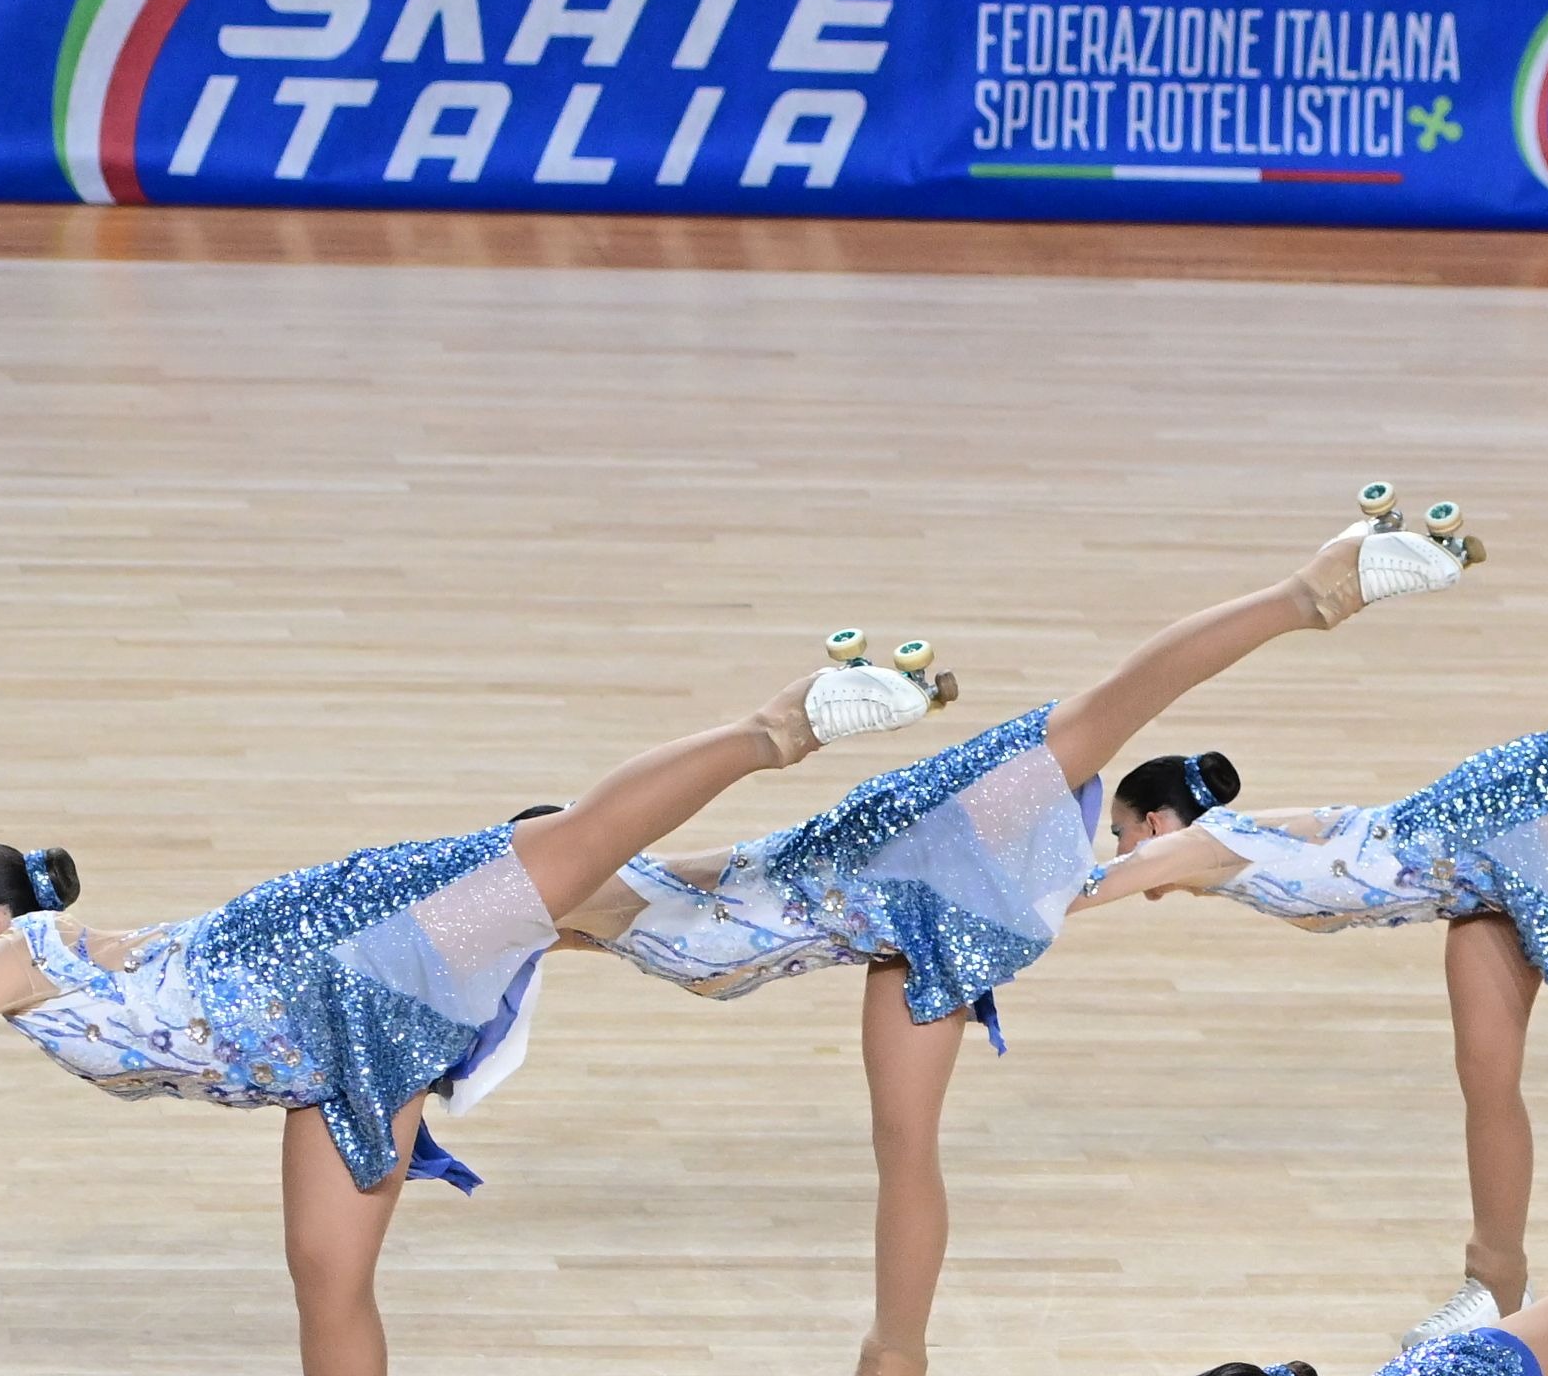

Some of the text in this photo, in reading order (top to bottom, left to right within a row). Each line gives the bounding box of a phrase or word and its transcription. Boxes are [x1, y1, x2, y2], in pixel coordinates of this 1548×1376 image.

[977, 3, 1460, 83] FEDERAZIONE ITALIANA
[167, 74, 867, 188] ITALIA
[973, 79, 1403, 156] SPORT ROTELLISTICI
